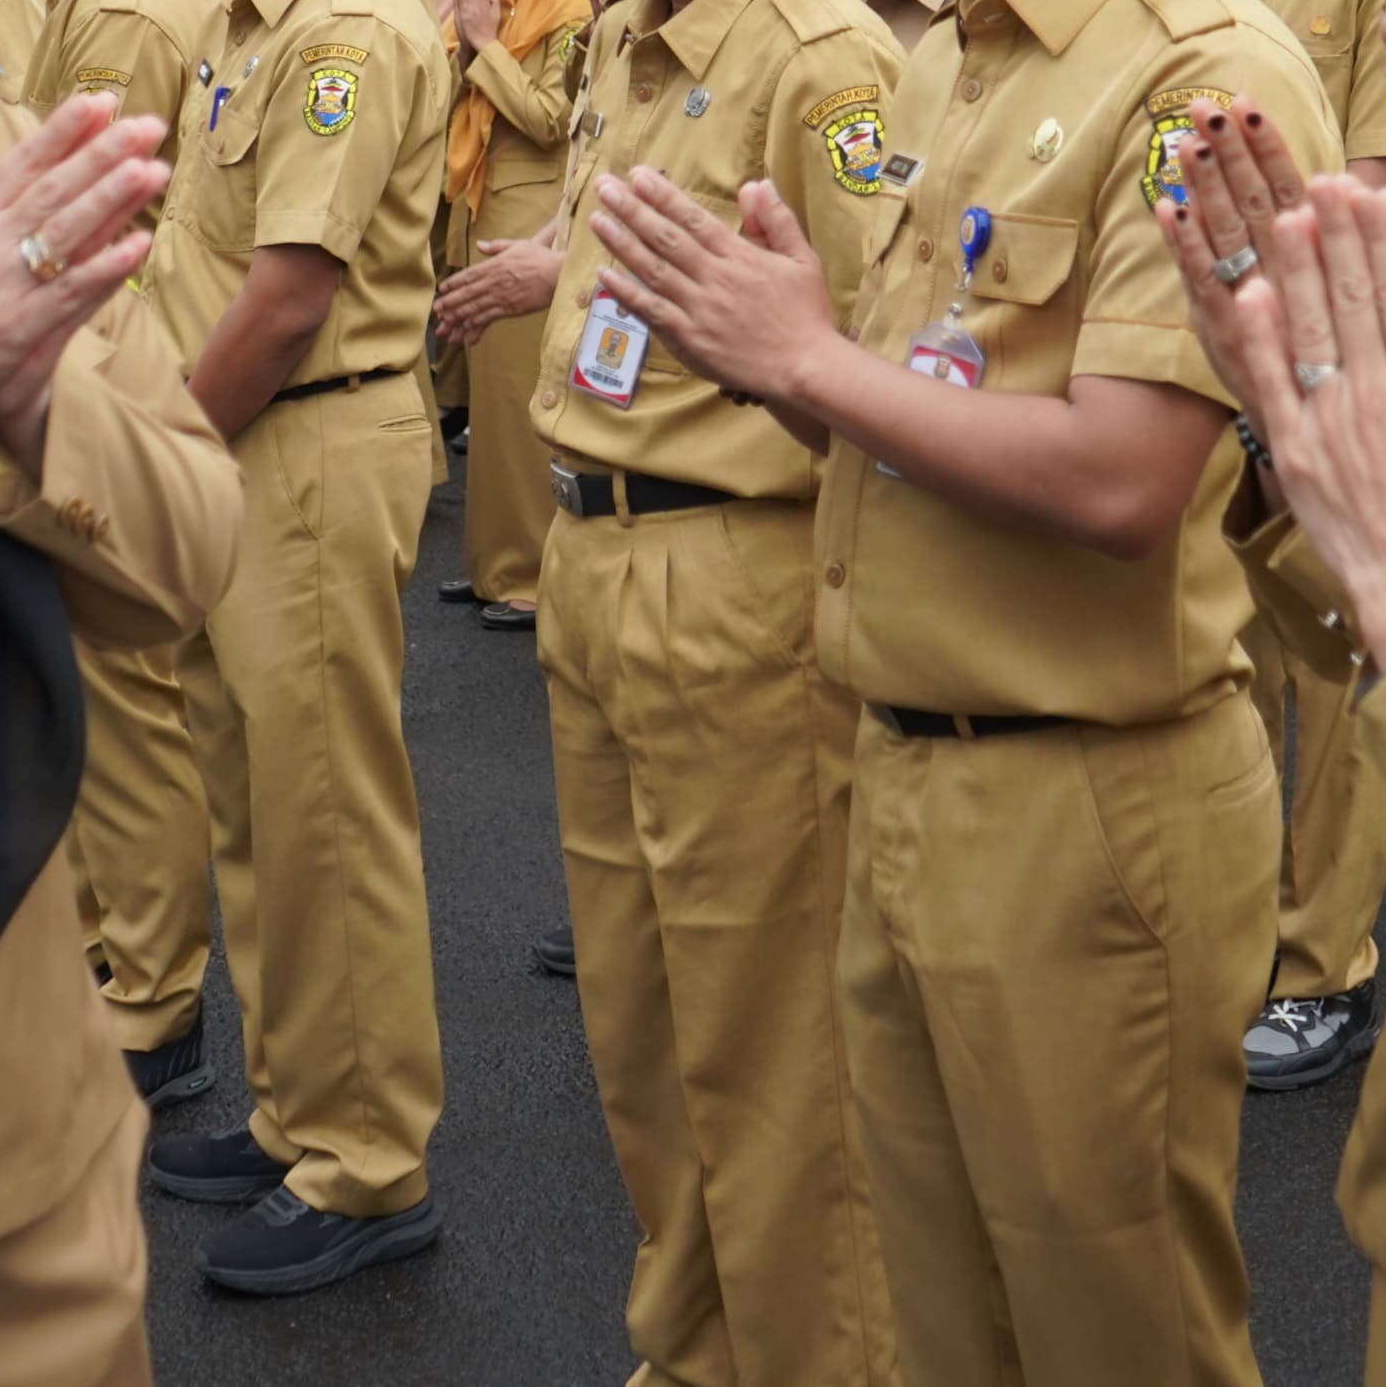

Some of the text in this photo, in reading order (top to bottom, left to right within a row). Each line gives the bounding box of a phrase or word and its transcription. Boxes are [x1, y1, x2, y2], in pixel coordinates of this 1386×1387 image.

[807, 87, 876, 124] PEMERINTAH KOTA
[837, 113, 864, 128] KOTA
